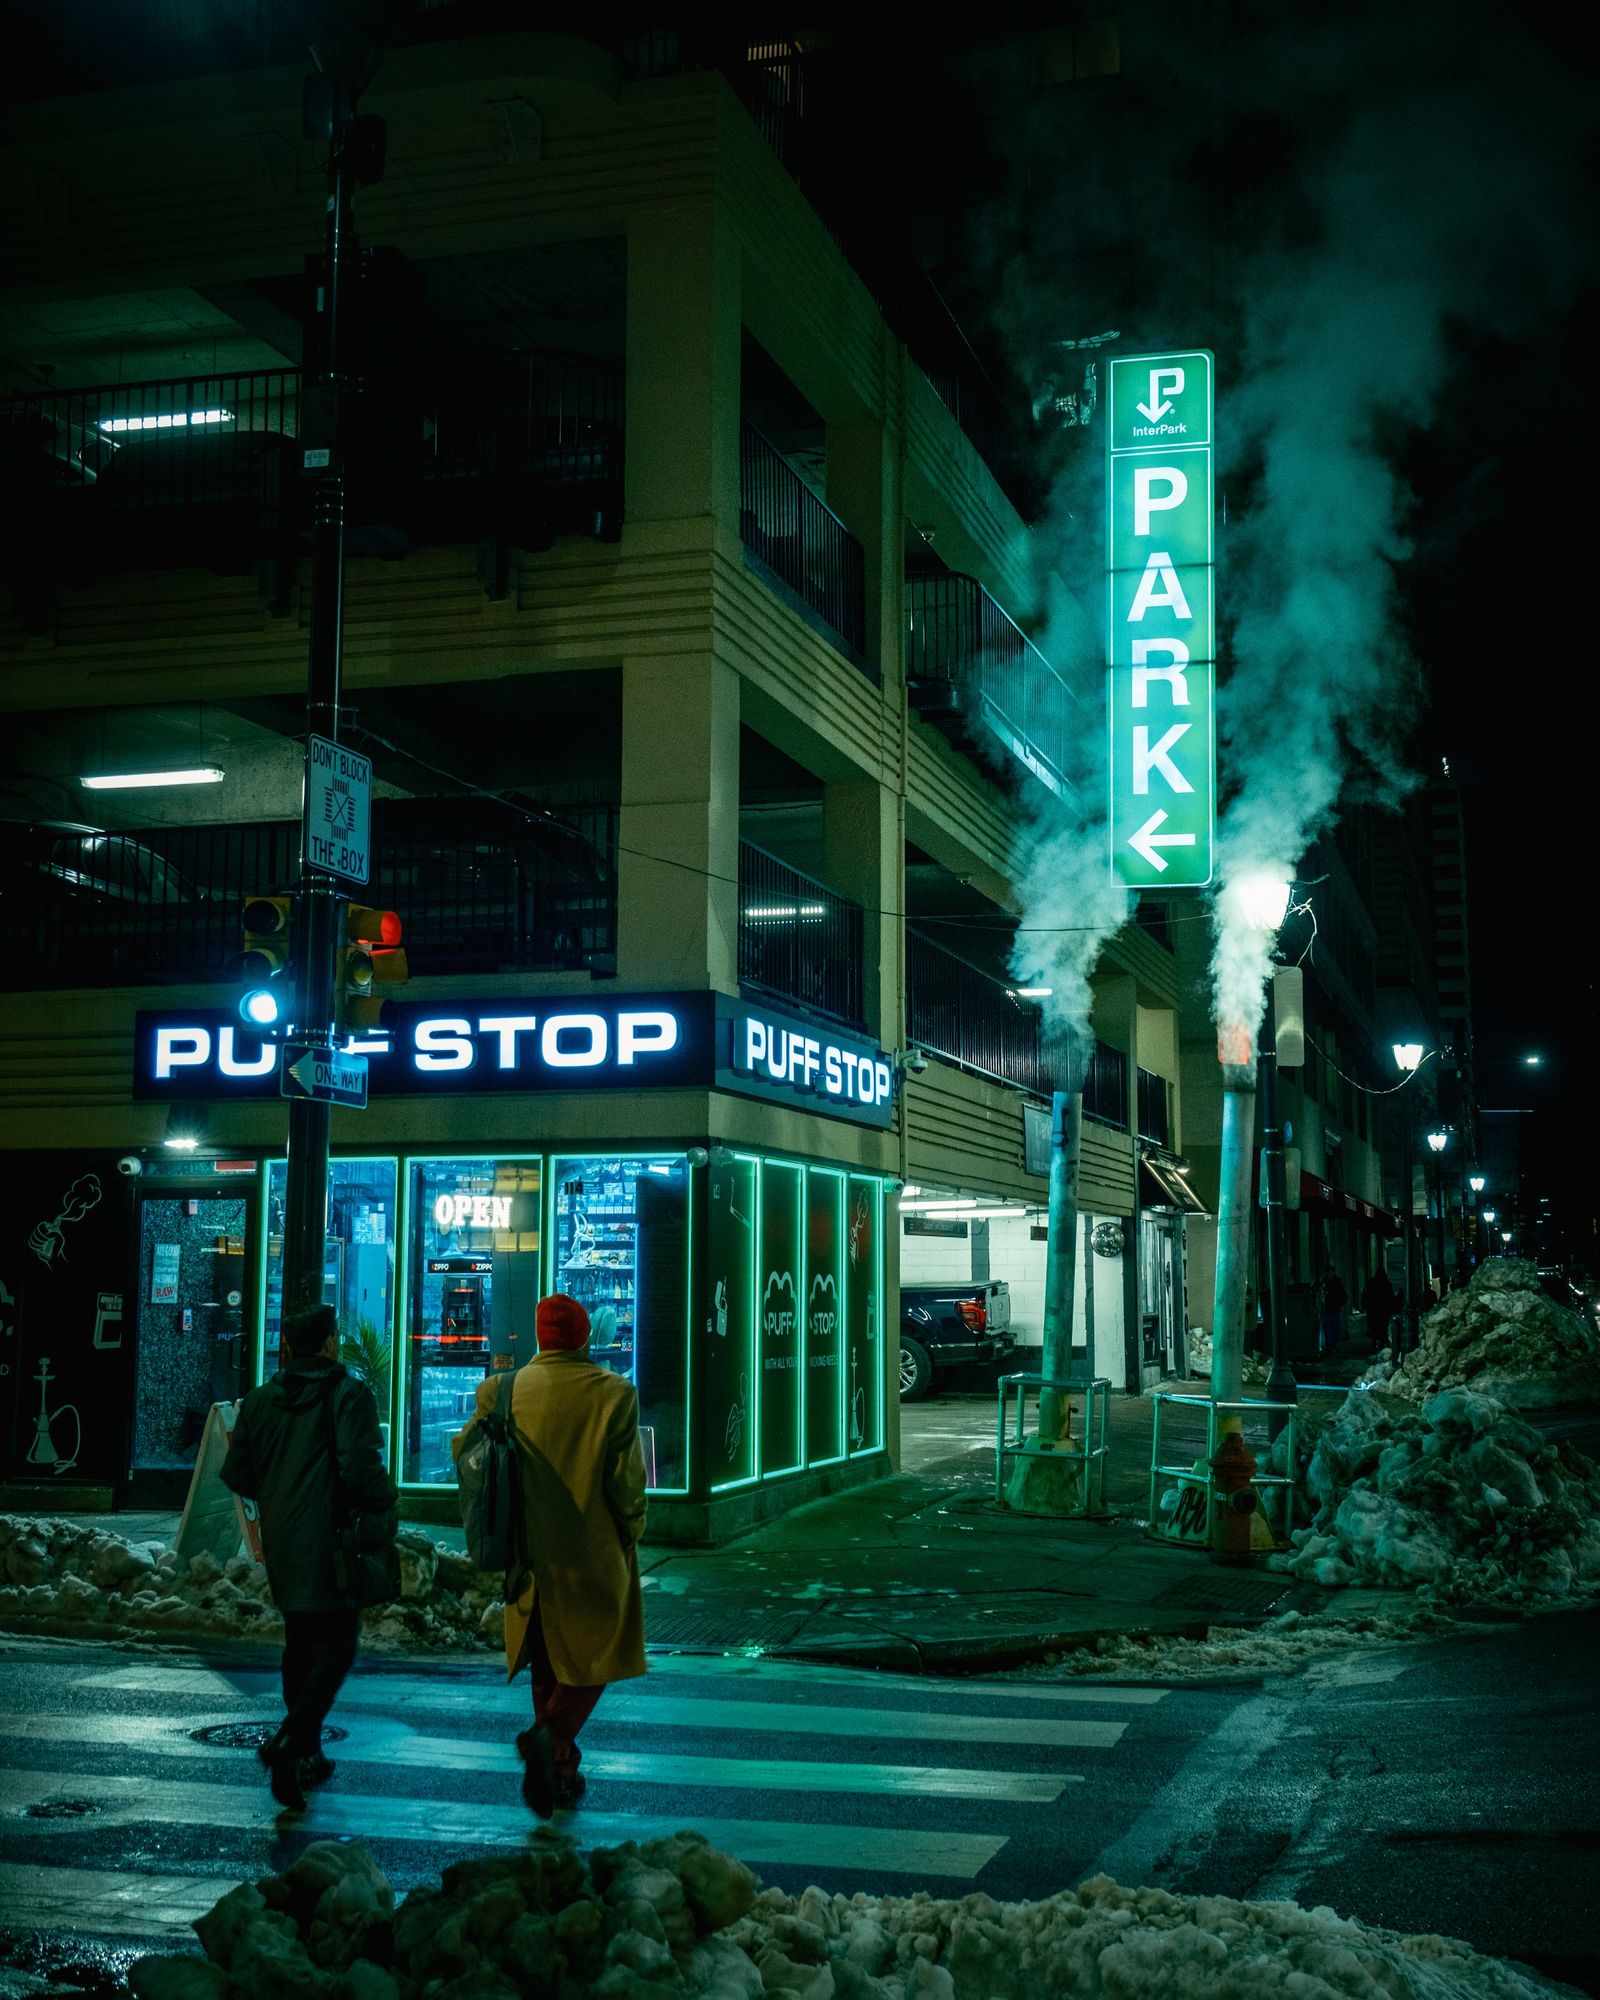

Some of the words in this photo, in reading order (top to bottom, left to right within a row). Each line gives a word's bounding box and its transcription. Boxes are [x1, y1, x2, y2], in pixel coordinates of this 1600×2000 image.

[1132, 422, 1187, 437] InterPark
[1126, 466, 1196, 794] PARK
[340, 754, 368, 784] BLOCK
[312, 835, 336, 866] THE
[341, 846, 365, 876] BOX
[414, 1011, 678, 1071] STOP
[746, 1016, 820, 1086] PUFF
[825, 1045, 890, 1106] STOP
[314, 1063, 340, 1086] ONE
[341, 1070, 360, 1089] WAY
[564, 1181, 584, 1195] 114
[435, 1194, 513, 1228] OPEN
[434, 1263, 449, 1271] ZIPPO
[155, 1287, 174, 1298] RAW
[768, 1312, 792, 1336] PUFF
[814, 1312, 835, 1335] STOP
